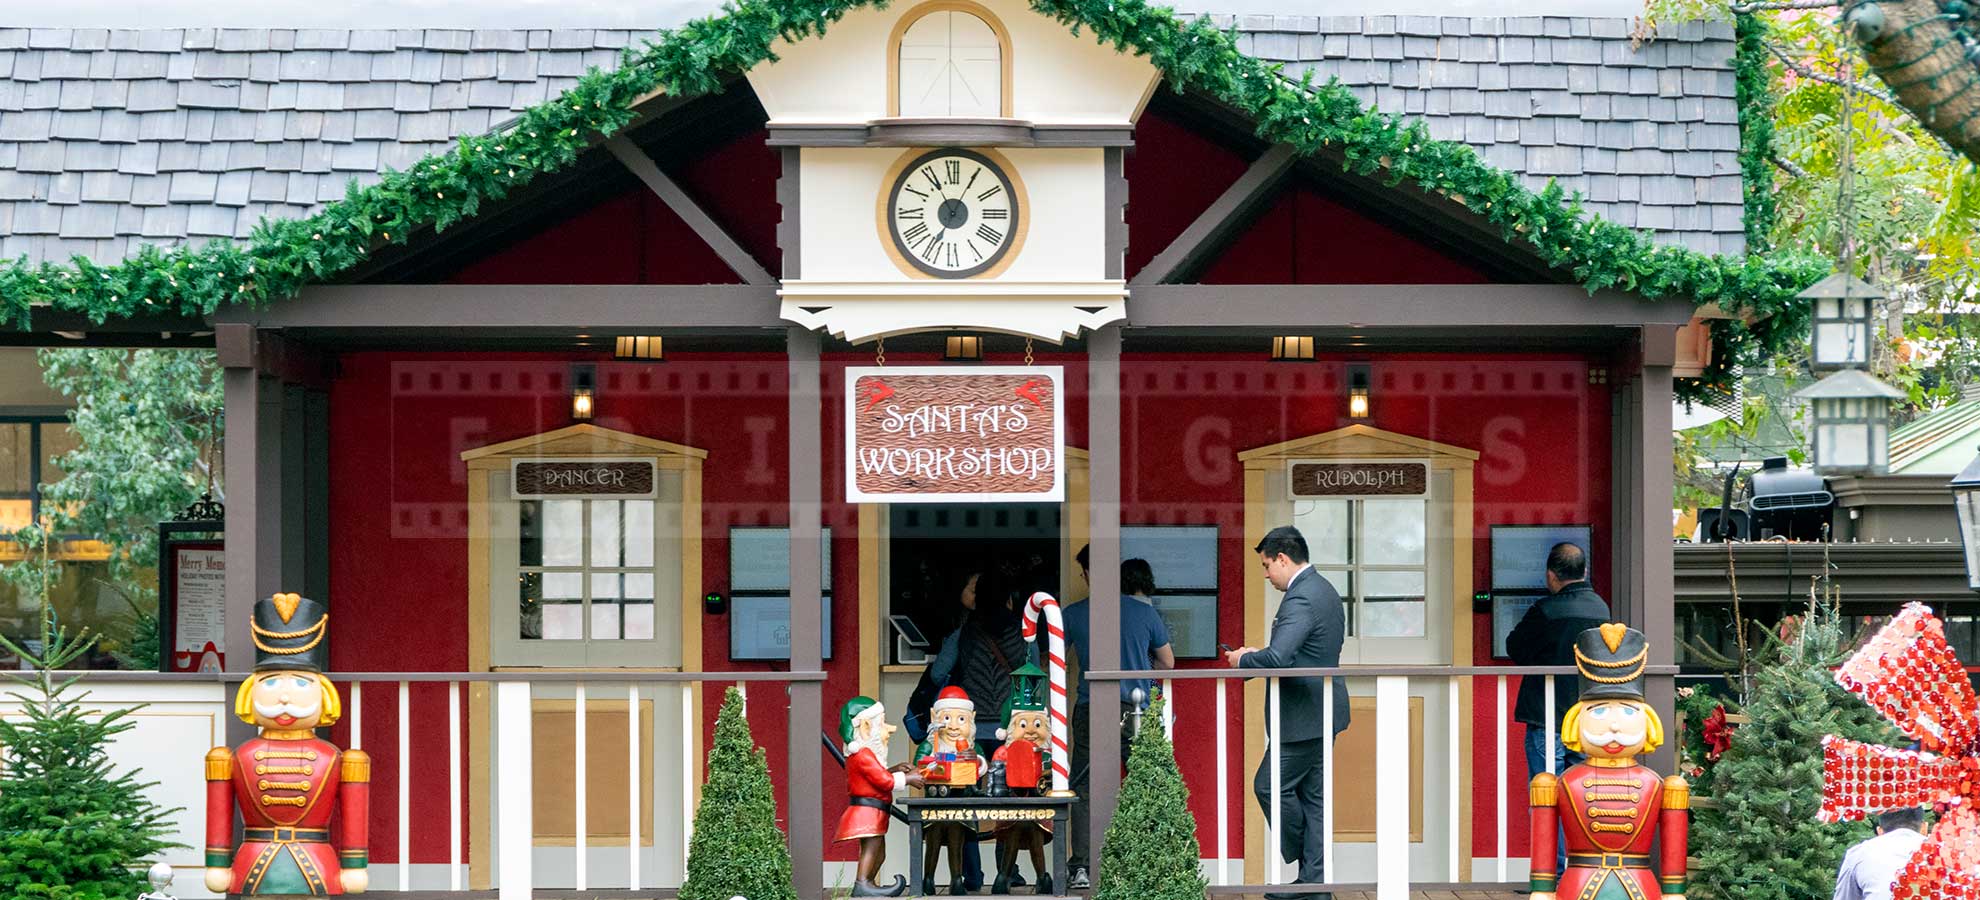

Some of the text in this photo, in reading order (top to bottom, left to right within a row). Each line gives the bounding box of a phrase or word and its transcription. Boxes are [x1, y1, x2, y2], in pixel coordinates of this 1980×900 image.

[882, 403, 1029, 438] SANTA'S
[859, 447, 1051, 480] WORKSHOP
[543, 468, 625, 487] DANCER
[1315, 469, 1404, 488] RUDOLPH
[180, 554, 203, 572] Merry
[921, 808, 1056, 821] SANTA'S WORKSHOP
